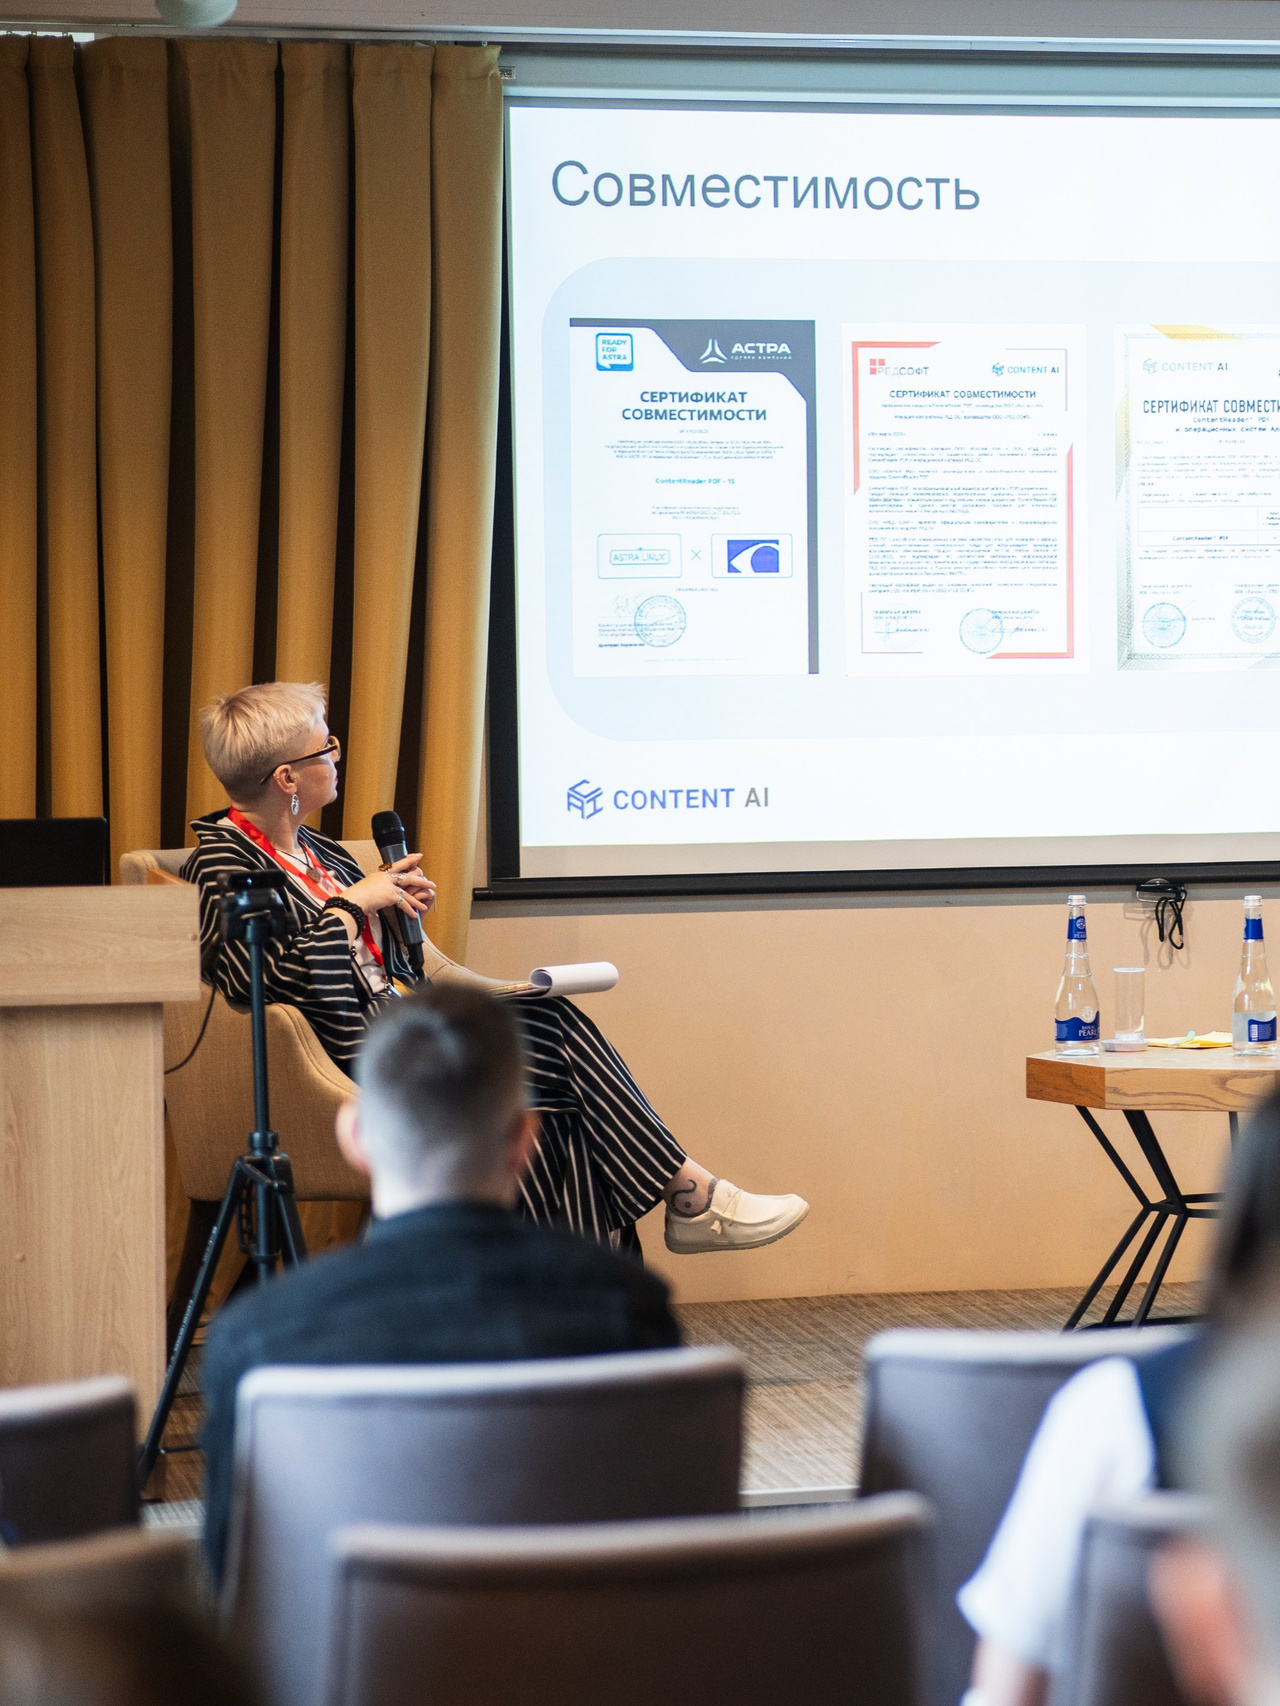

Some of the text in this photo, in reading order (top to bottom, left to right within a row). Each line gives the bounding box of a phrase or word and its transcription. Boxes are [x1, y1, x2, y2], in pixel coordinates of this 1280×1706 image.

[551, 159, 981, 211] Совместимость
[731, 343, 792, 354] АСТРА
[1007, 366, 1060, 374] CONTENT AI
[1161, 362, 1228, 371] CONTENT AI
[640, 391, 748, 403] СЕРТИФИКАТ
[889, 390, 1037, 399] СЕРТИФИКАТ СОВМЕСТИМОСТИ
[1143, 400, 1218, 413] СЕРТИФИКАТ
[621, 408, 767, 421] СОВМЕСТИМОСТИ
[614, 553, 639, 561] ASTRA
[613, 787, 769, 810] CONTENT AI
